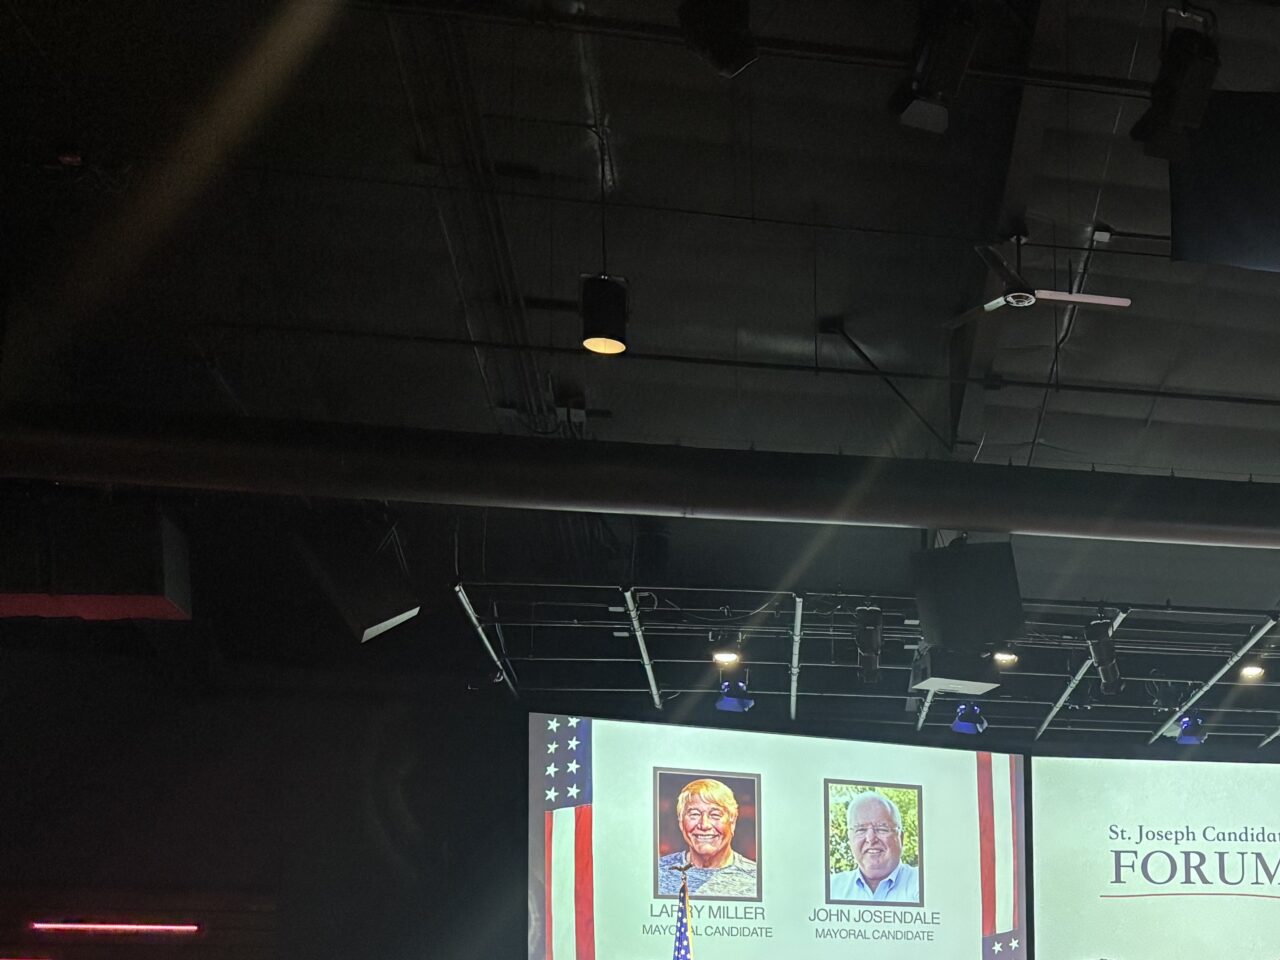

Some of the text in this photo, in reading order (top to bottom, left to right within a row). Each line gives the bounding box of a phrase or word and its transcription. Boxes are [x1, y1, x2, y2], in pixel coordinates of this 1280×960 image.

[1109, 824, 1132, 841] St.
[1135, 825, 1196, 845] Joseph
[708, 905, 766, 920] MILLER
[808, 908, 941, 925] JOHN JOSENDALE
[704, 925, 773, 938] CANDIDATE
[815, 928, 935, 941] MAYORAL CANDIDATE
